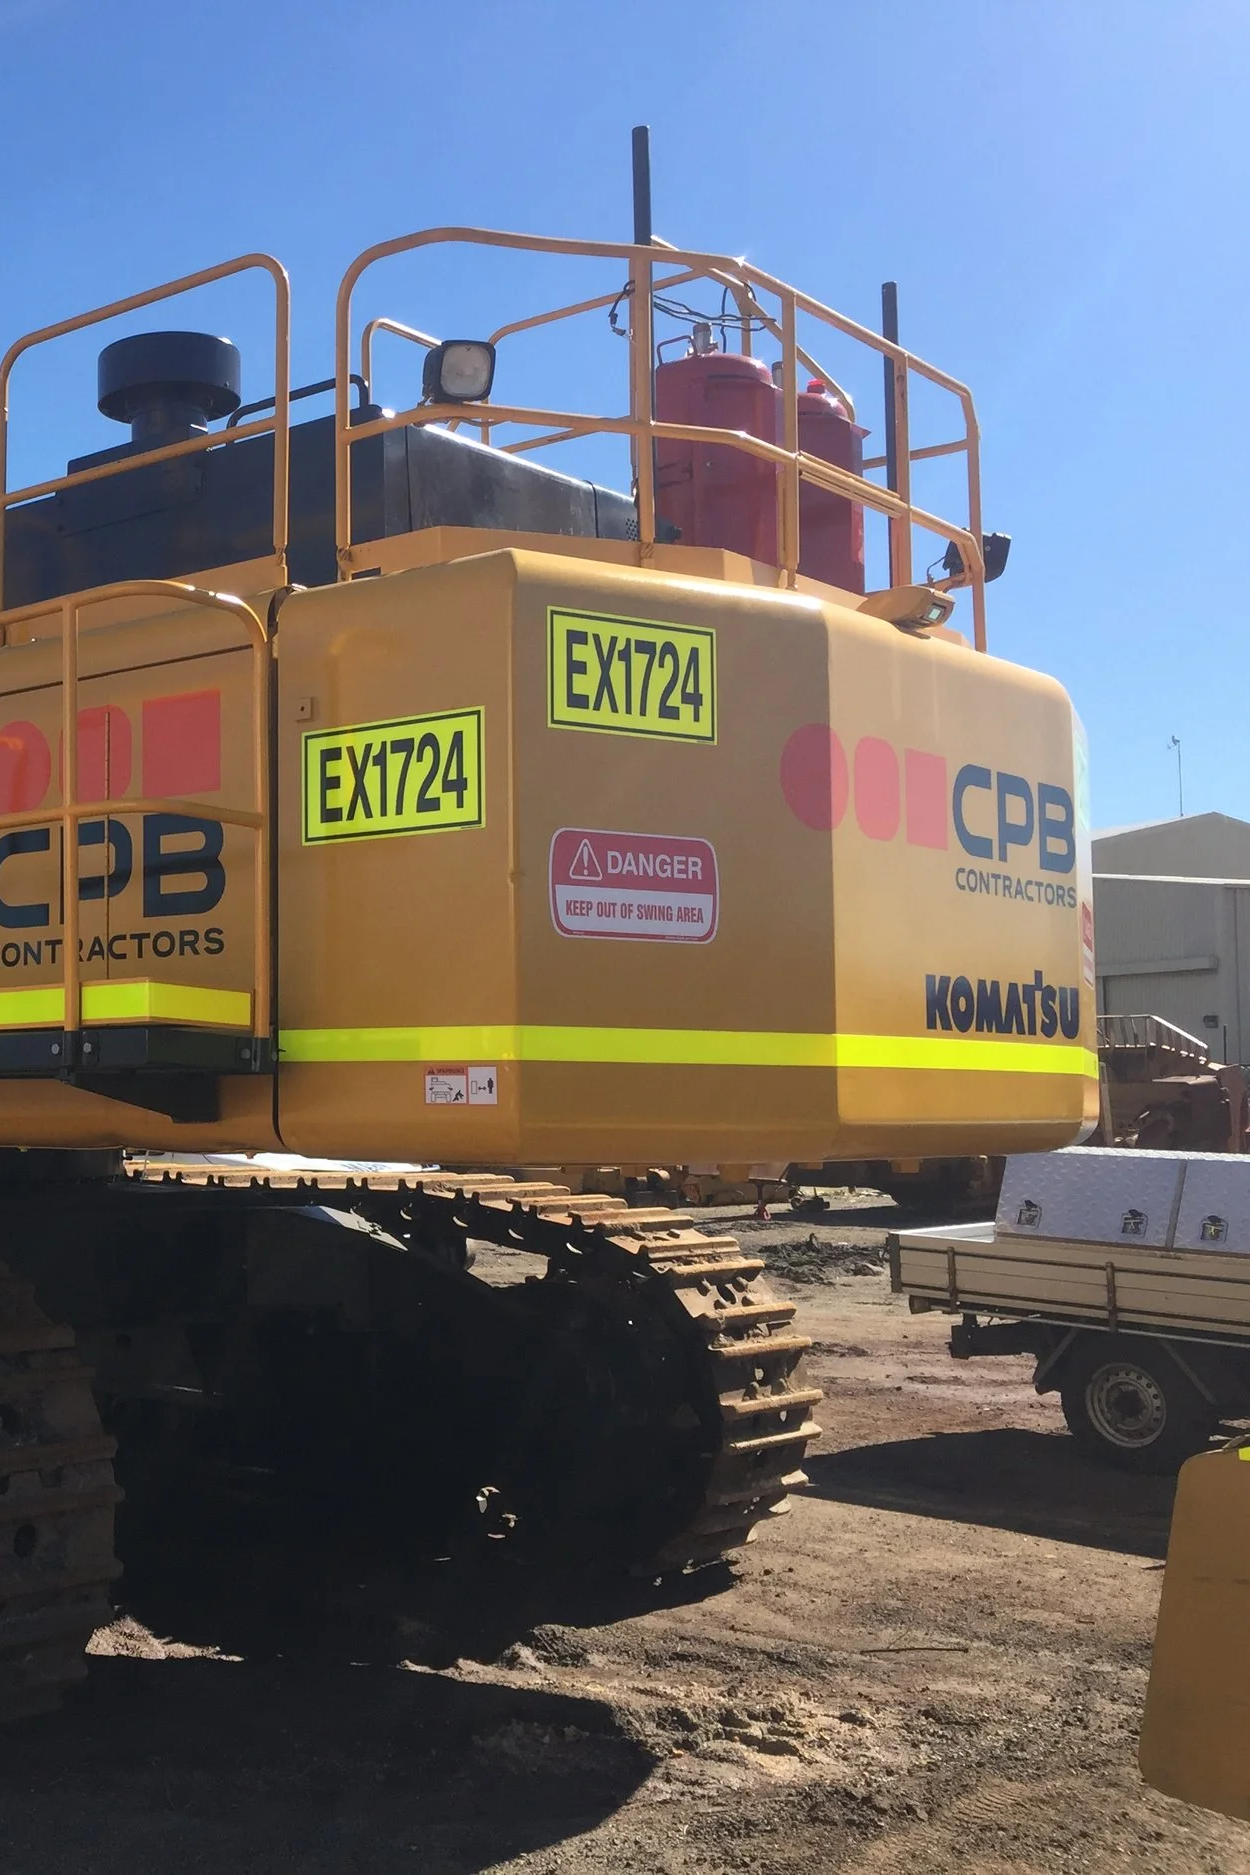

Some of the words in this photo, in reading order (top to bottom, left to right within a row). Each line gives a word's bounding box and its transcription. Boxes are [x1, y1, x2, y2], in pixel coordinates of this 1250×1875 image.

[566, 629, 703, 723] EX1724
[320, 730, 468, 824] EX1724
[952, 763, 1076, 875] CPB
[607, 850, 703, 880] DANGER
[955, 867, 1077, 909] CONTRACTORS
[565, 899, 593, 917] KEEP
[597, 901, 618, 918] OUT
[620, 902, 634, 920] OF
[637, 904, 673, 922] SWING
[676, 907, 704, 924] AREA
[925, 969, 1080, 1040] KOMATSU
